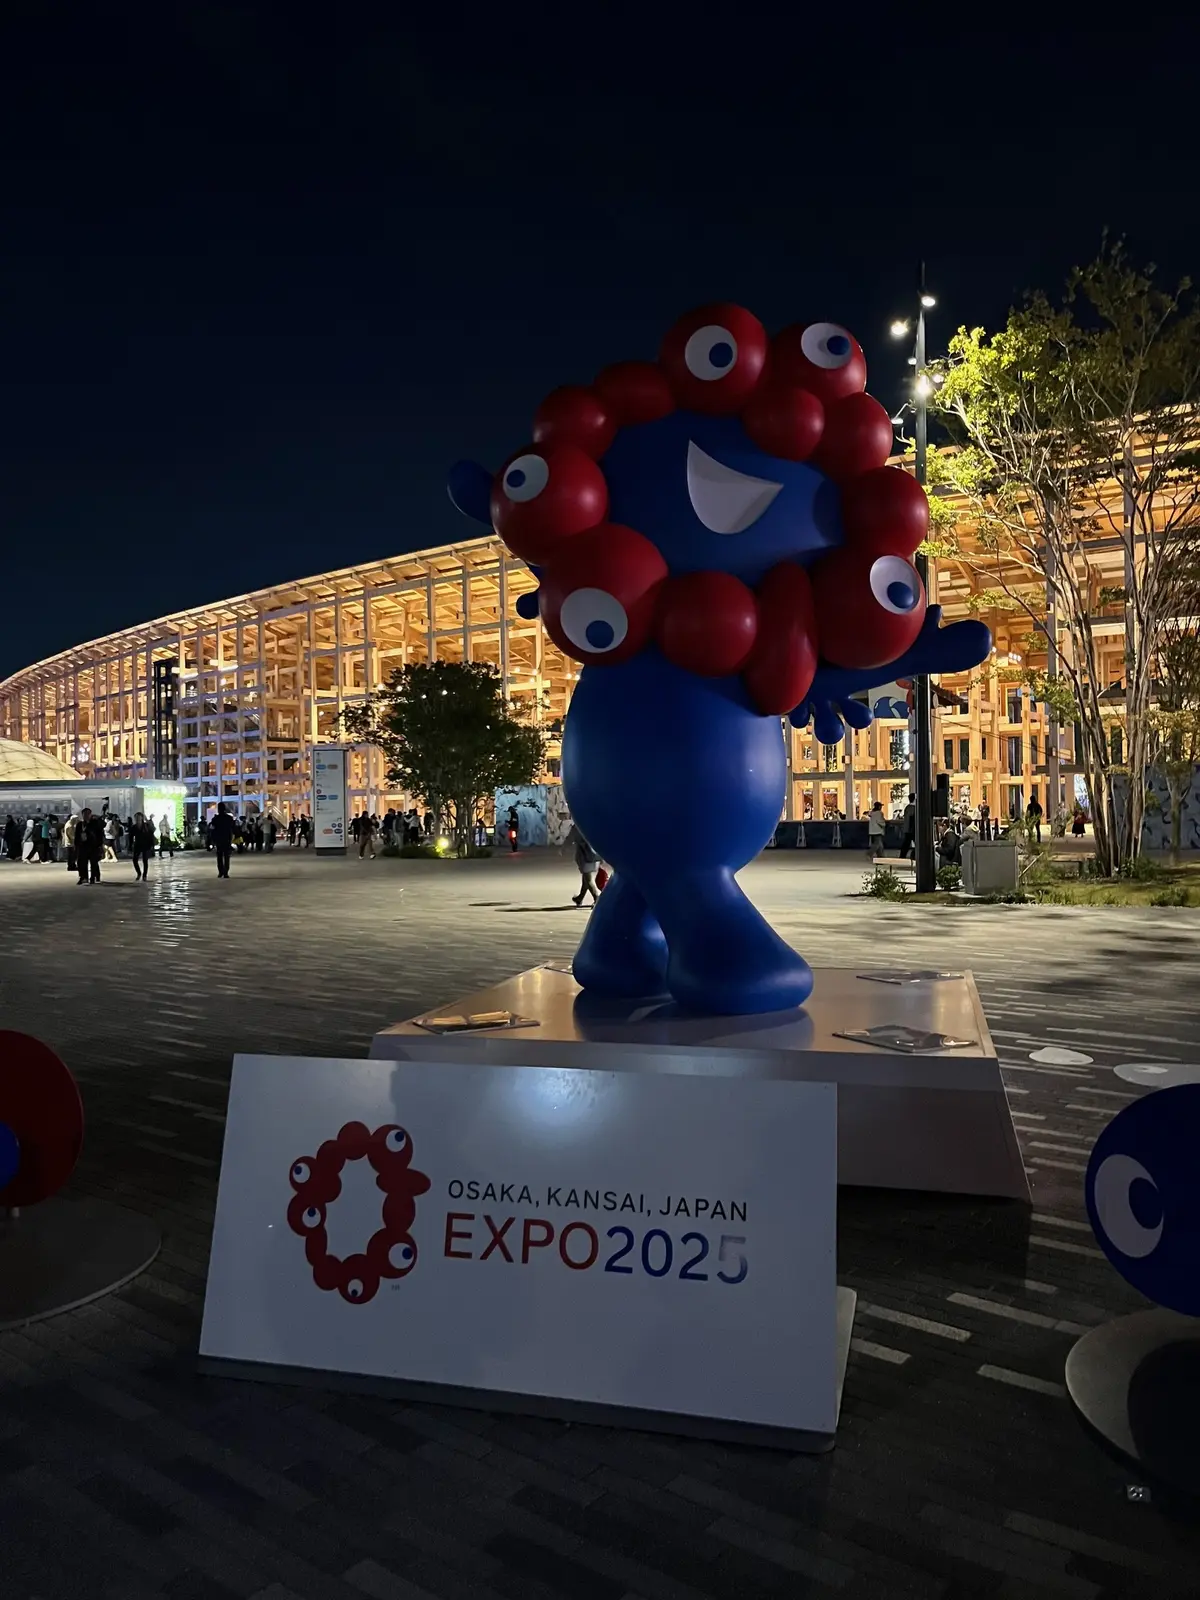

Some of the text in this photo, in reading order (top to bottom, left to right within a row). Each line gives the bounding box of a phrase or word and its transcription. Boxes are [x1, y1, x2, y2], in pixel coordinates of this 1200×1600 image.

[448, 1179, 748, 1222] OSAKA, KANSAI, JAPAN
